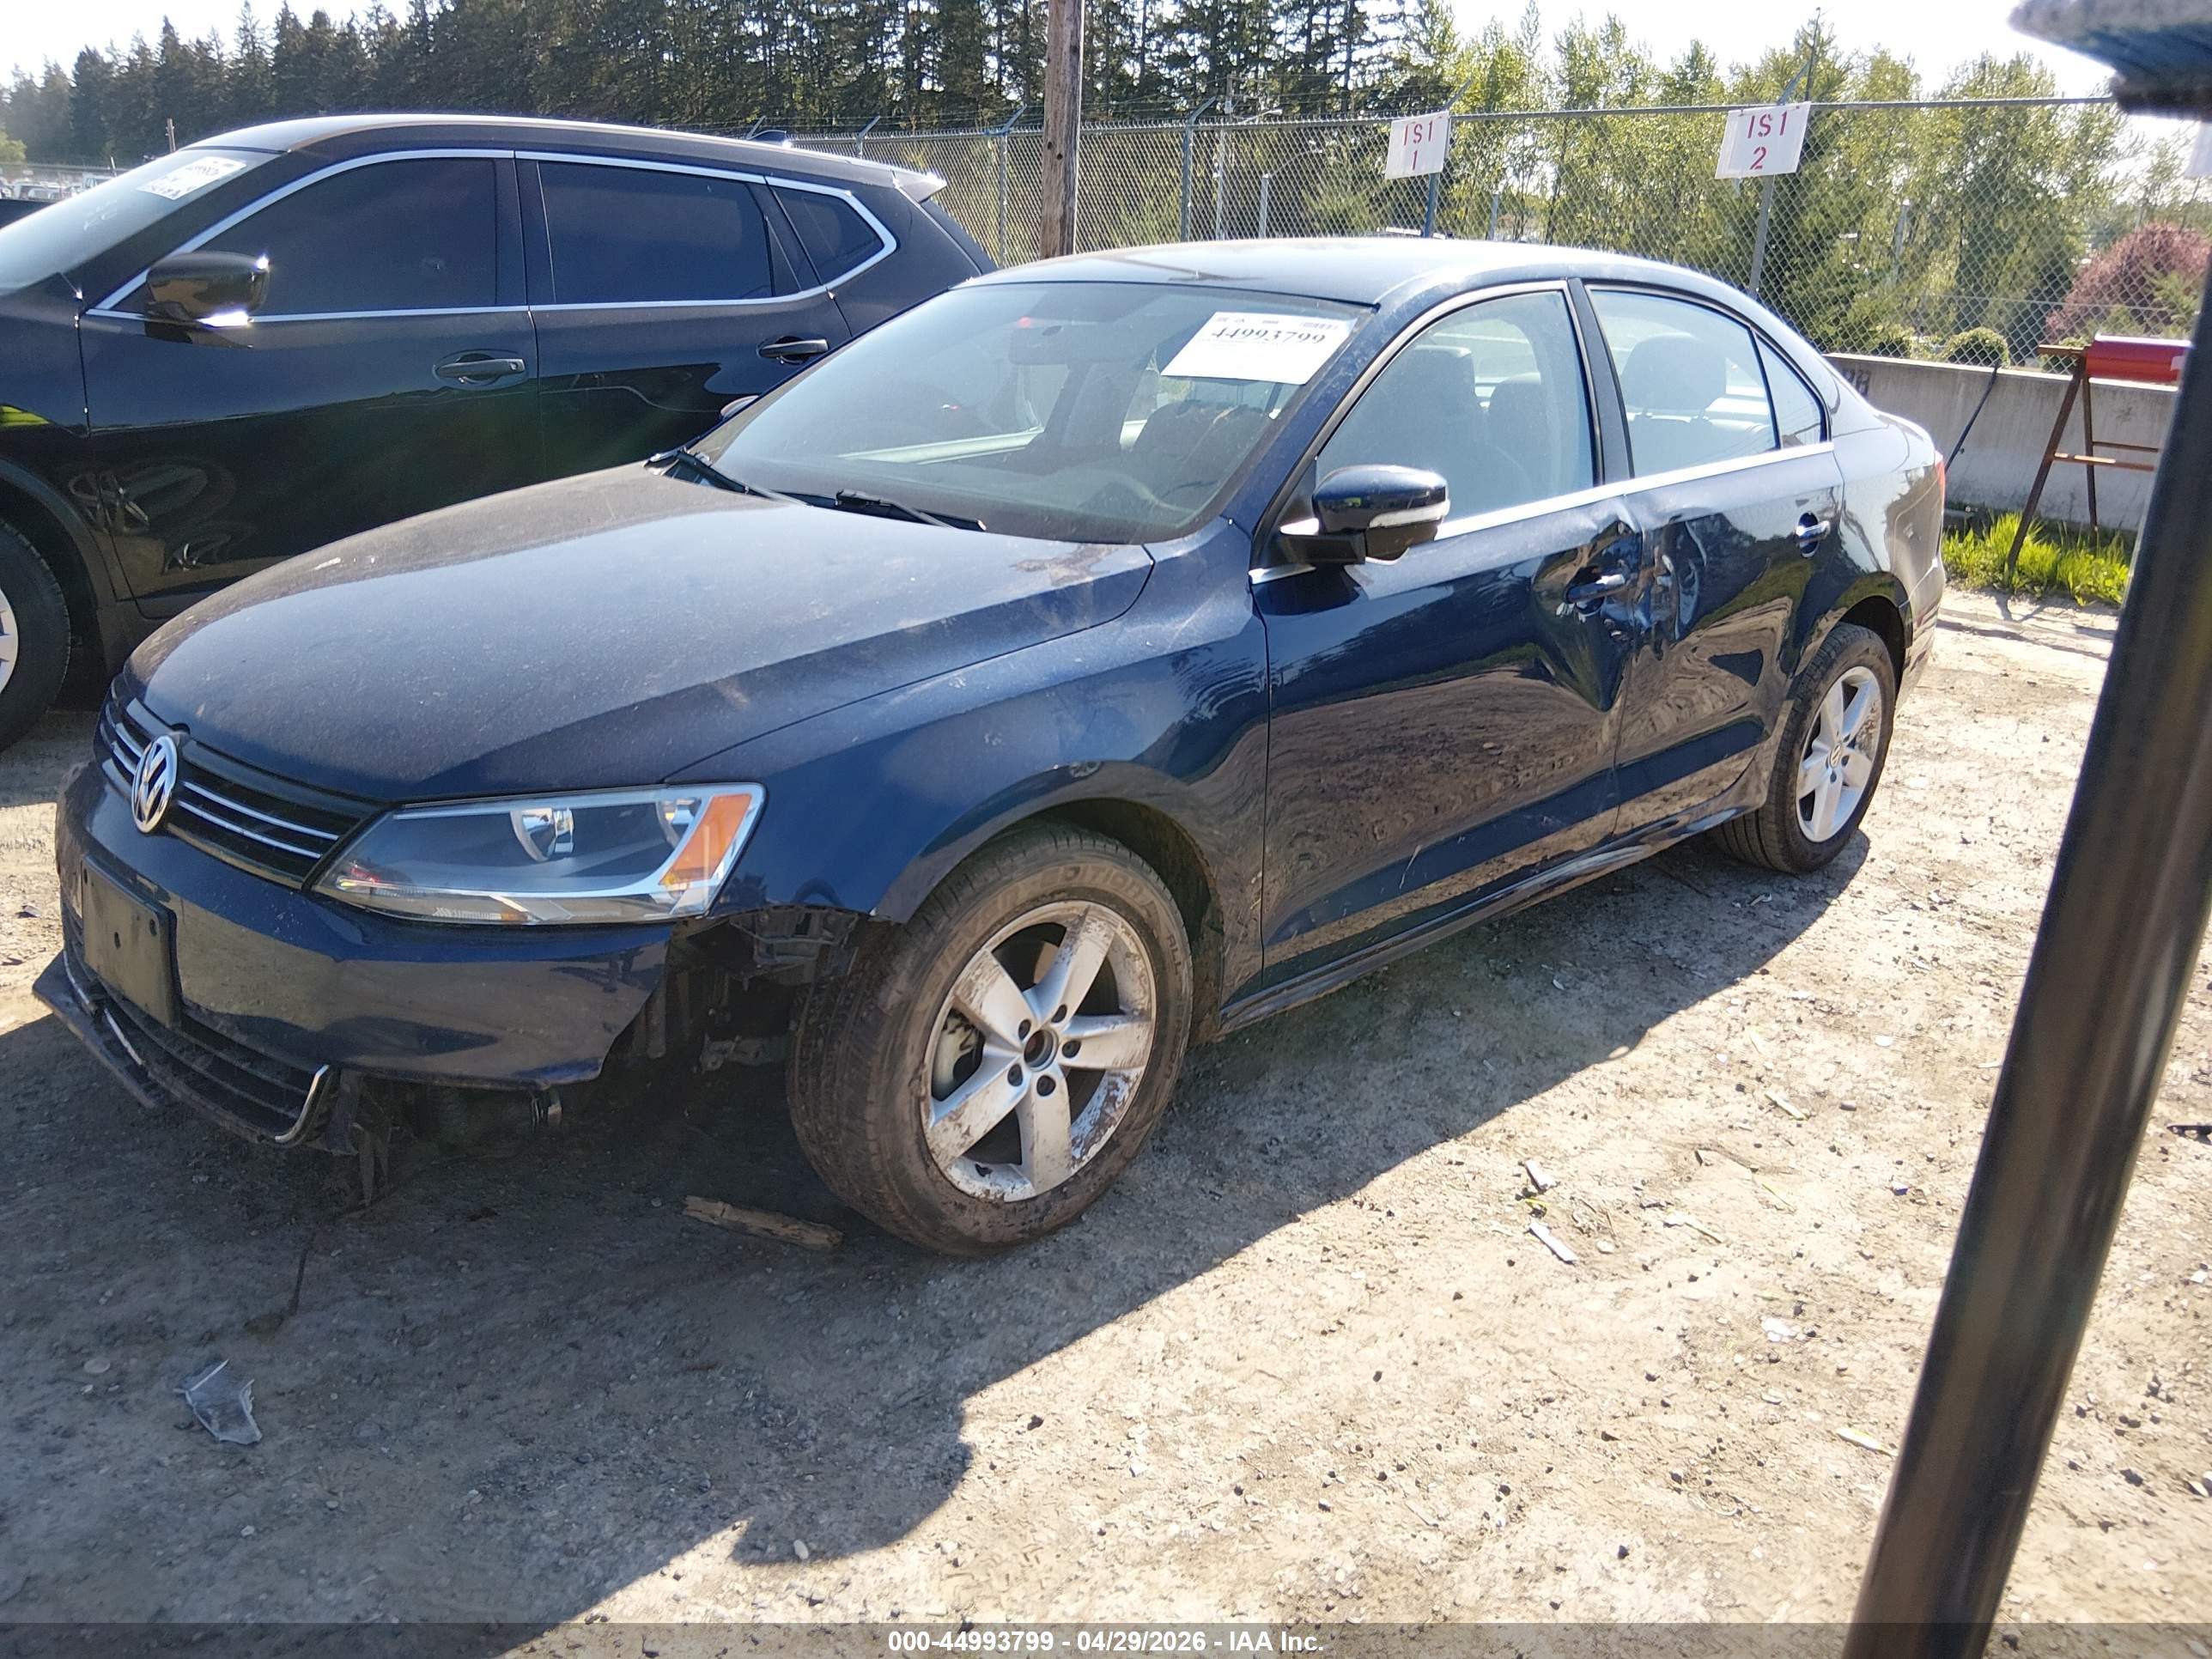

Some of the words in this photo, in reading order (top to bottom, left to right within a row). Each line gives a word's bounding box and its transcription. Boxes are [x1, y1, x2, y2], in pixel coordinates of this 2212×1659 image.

[1412, 149, 1419, 171] 1
[1749, 146, 1767, 170] 2
[1212, 326, 1327, 344] 44993799
